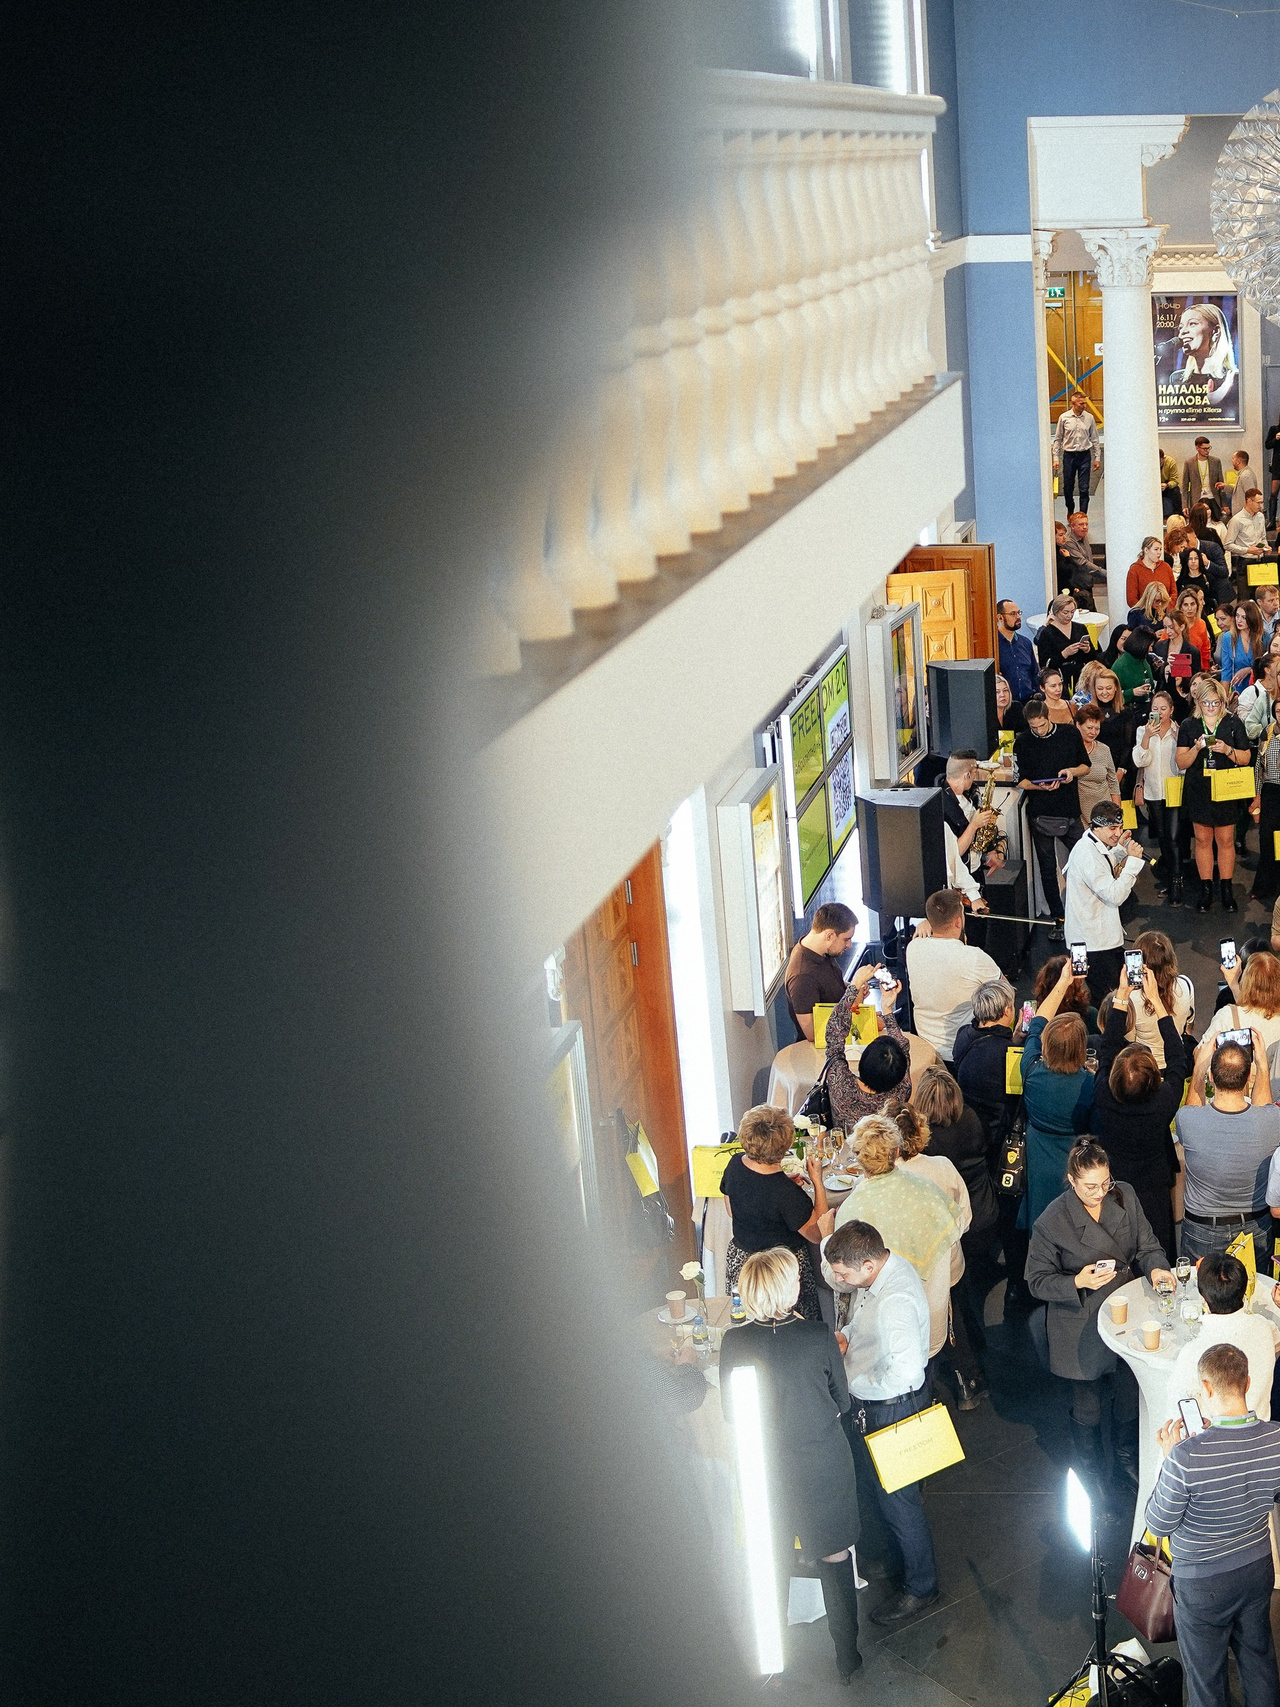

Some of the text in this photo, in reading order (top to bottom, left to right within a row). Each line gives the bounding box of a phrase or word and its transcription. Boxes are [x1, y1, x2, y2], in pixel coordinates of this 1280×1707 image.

[1158, 384, 1209, 395] НАТАЛЬЯ
[1158, 395, 1211, 407] ШИЛОВА
[899, 1437, 934, 1456] FREEDOM
